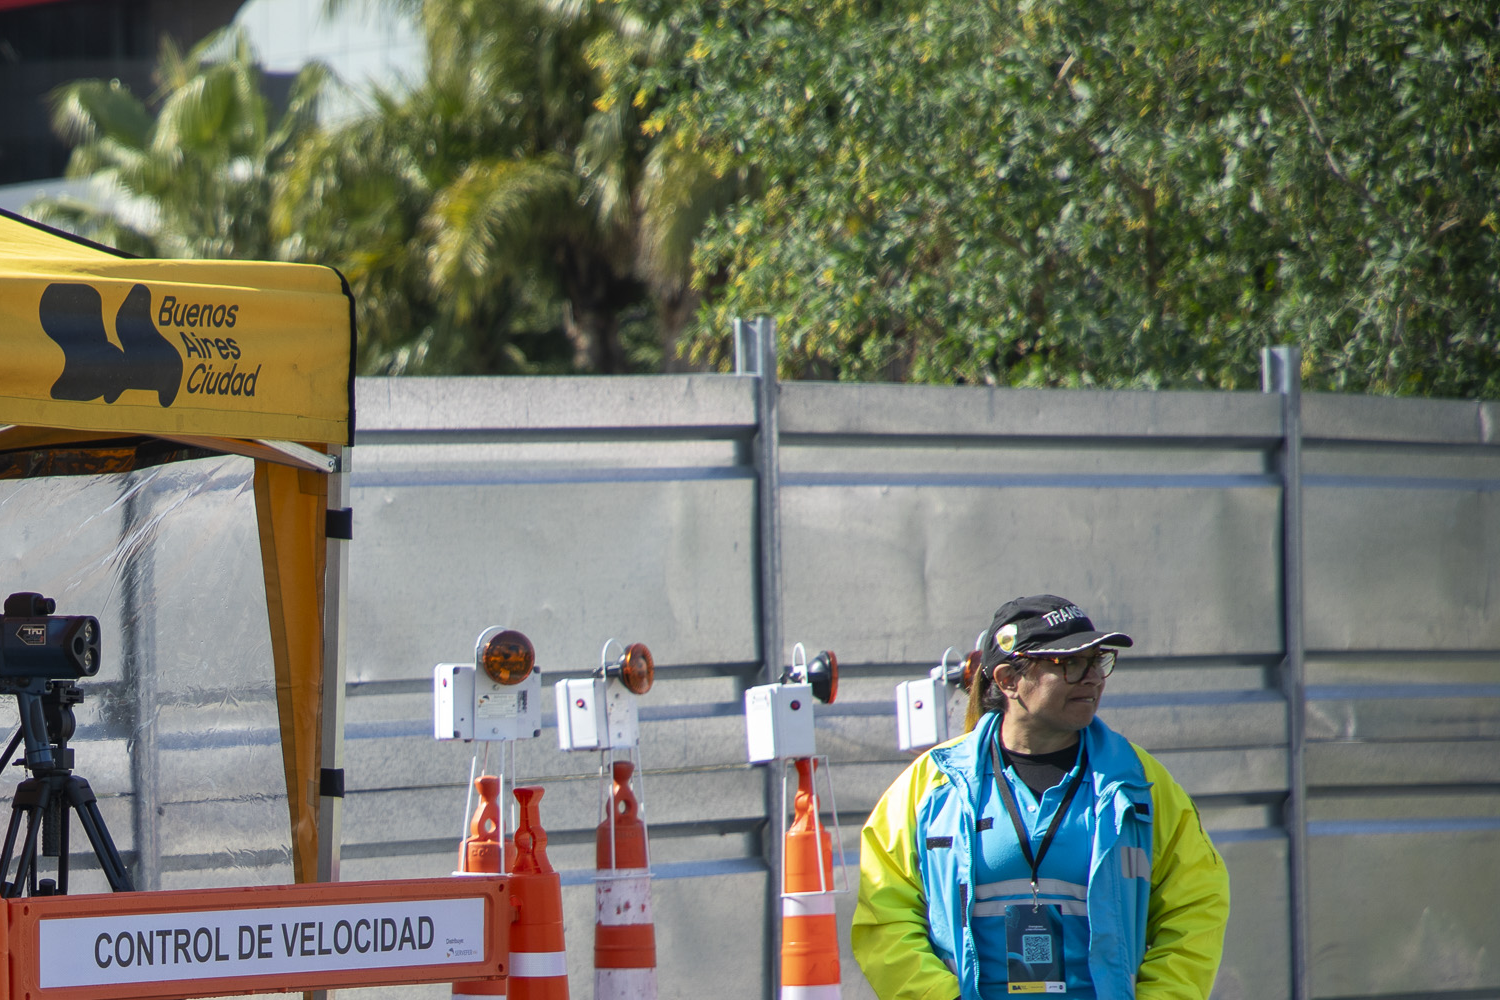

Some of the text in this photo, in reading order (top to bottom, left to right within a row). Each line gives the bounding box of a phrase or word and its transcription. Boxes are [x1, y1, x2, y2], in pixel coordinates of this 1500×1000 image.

[158, 295, 240, 329] Buenos
[182, 331, 242, 361] Aires
[186, 363, 262, 397] Ciudad
[94, 915, 436, 969] CONTROL DE VELOCIDAD
